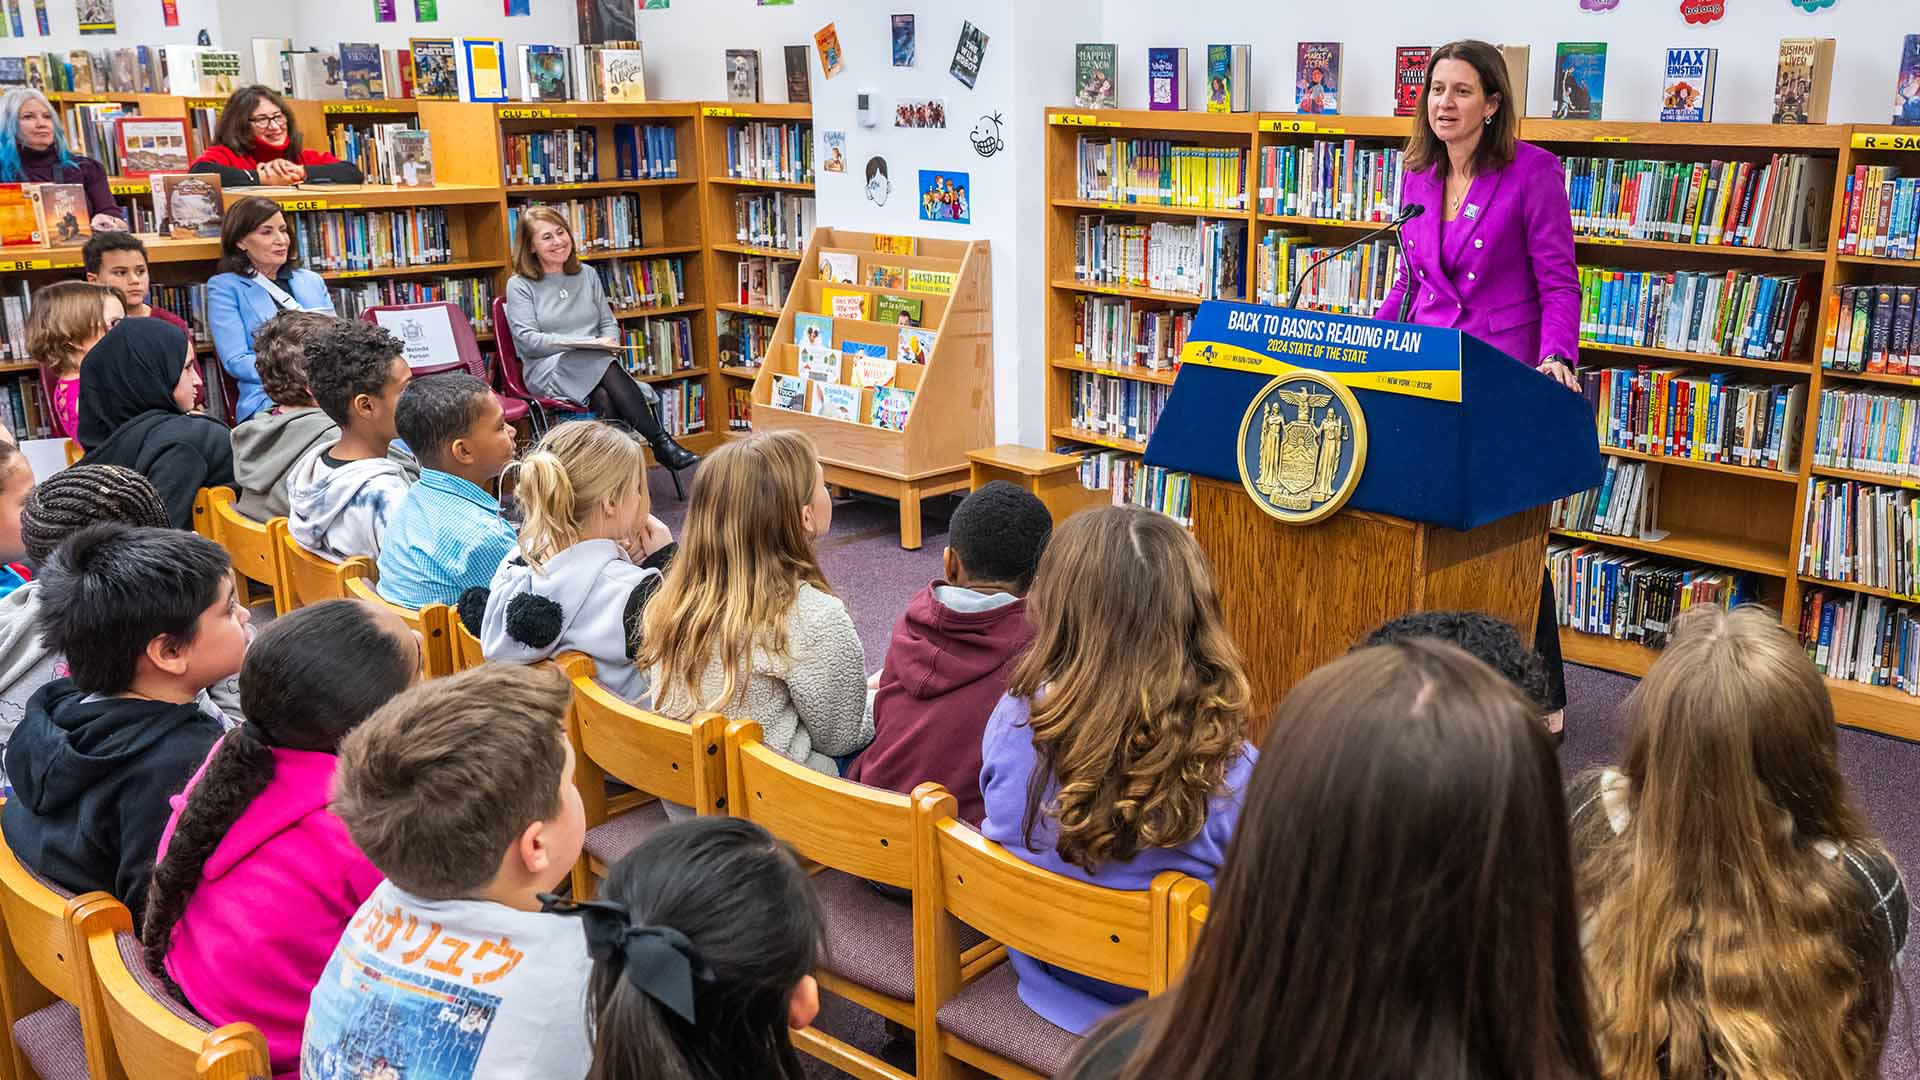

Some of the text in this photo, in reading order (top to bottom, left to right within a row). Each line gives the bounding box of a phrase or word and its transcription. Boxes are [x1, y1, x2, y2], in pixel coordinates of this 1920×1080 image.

[1686, 5, 1719, 15] belong
[966, 40, 979, 52] THE
[1780, 45, 1814, 57] BUSHMAN
[960, 46, 978, 62] WILD
[1668, 51, 1704, 65] MAX
[955, 52, 978, 73] ROBOT
[1305, 60, 1329, 68] SCENE
[1667, 66, 1703, 75] EINSTEIN
[503, 110, 521, 118] CLU
[1062, 115, 1069, 124] K
[1077, 116, 1083, 124] L
[1273, 122, 1282, 131] M
[1292, 122, 1300, 132] O
[1865, 137, 1876, 148] R
[297, 202, 318, 210] CLE
[15, 261, 32, 270] BE
[1228, 310, 1422, 353] BACK TO BASICS READING PLAN
[1267, 339, 1368, 364] 2024 STATE OF THE STATE
